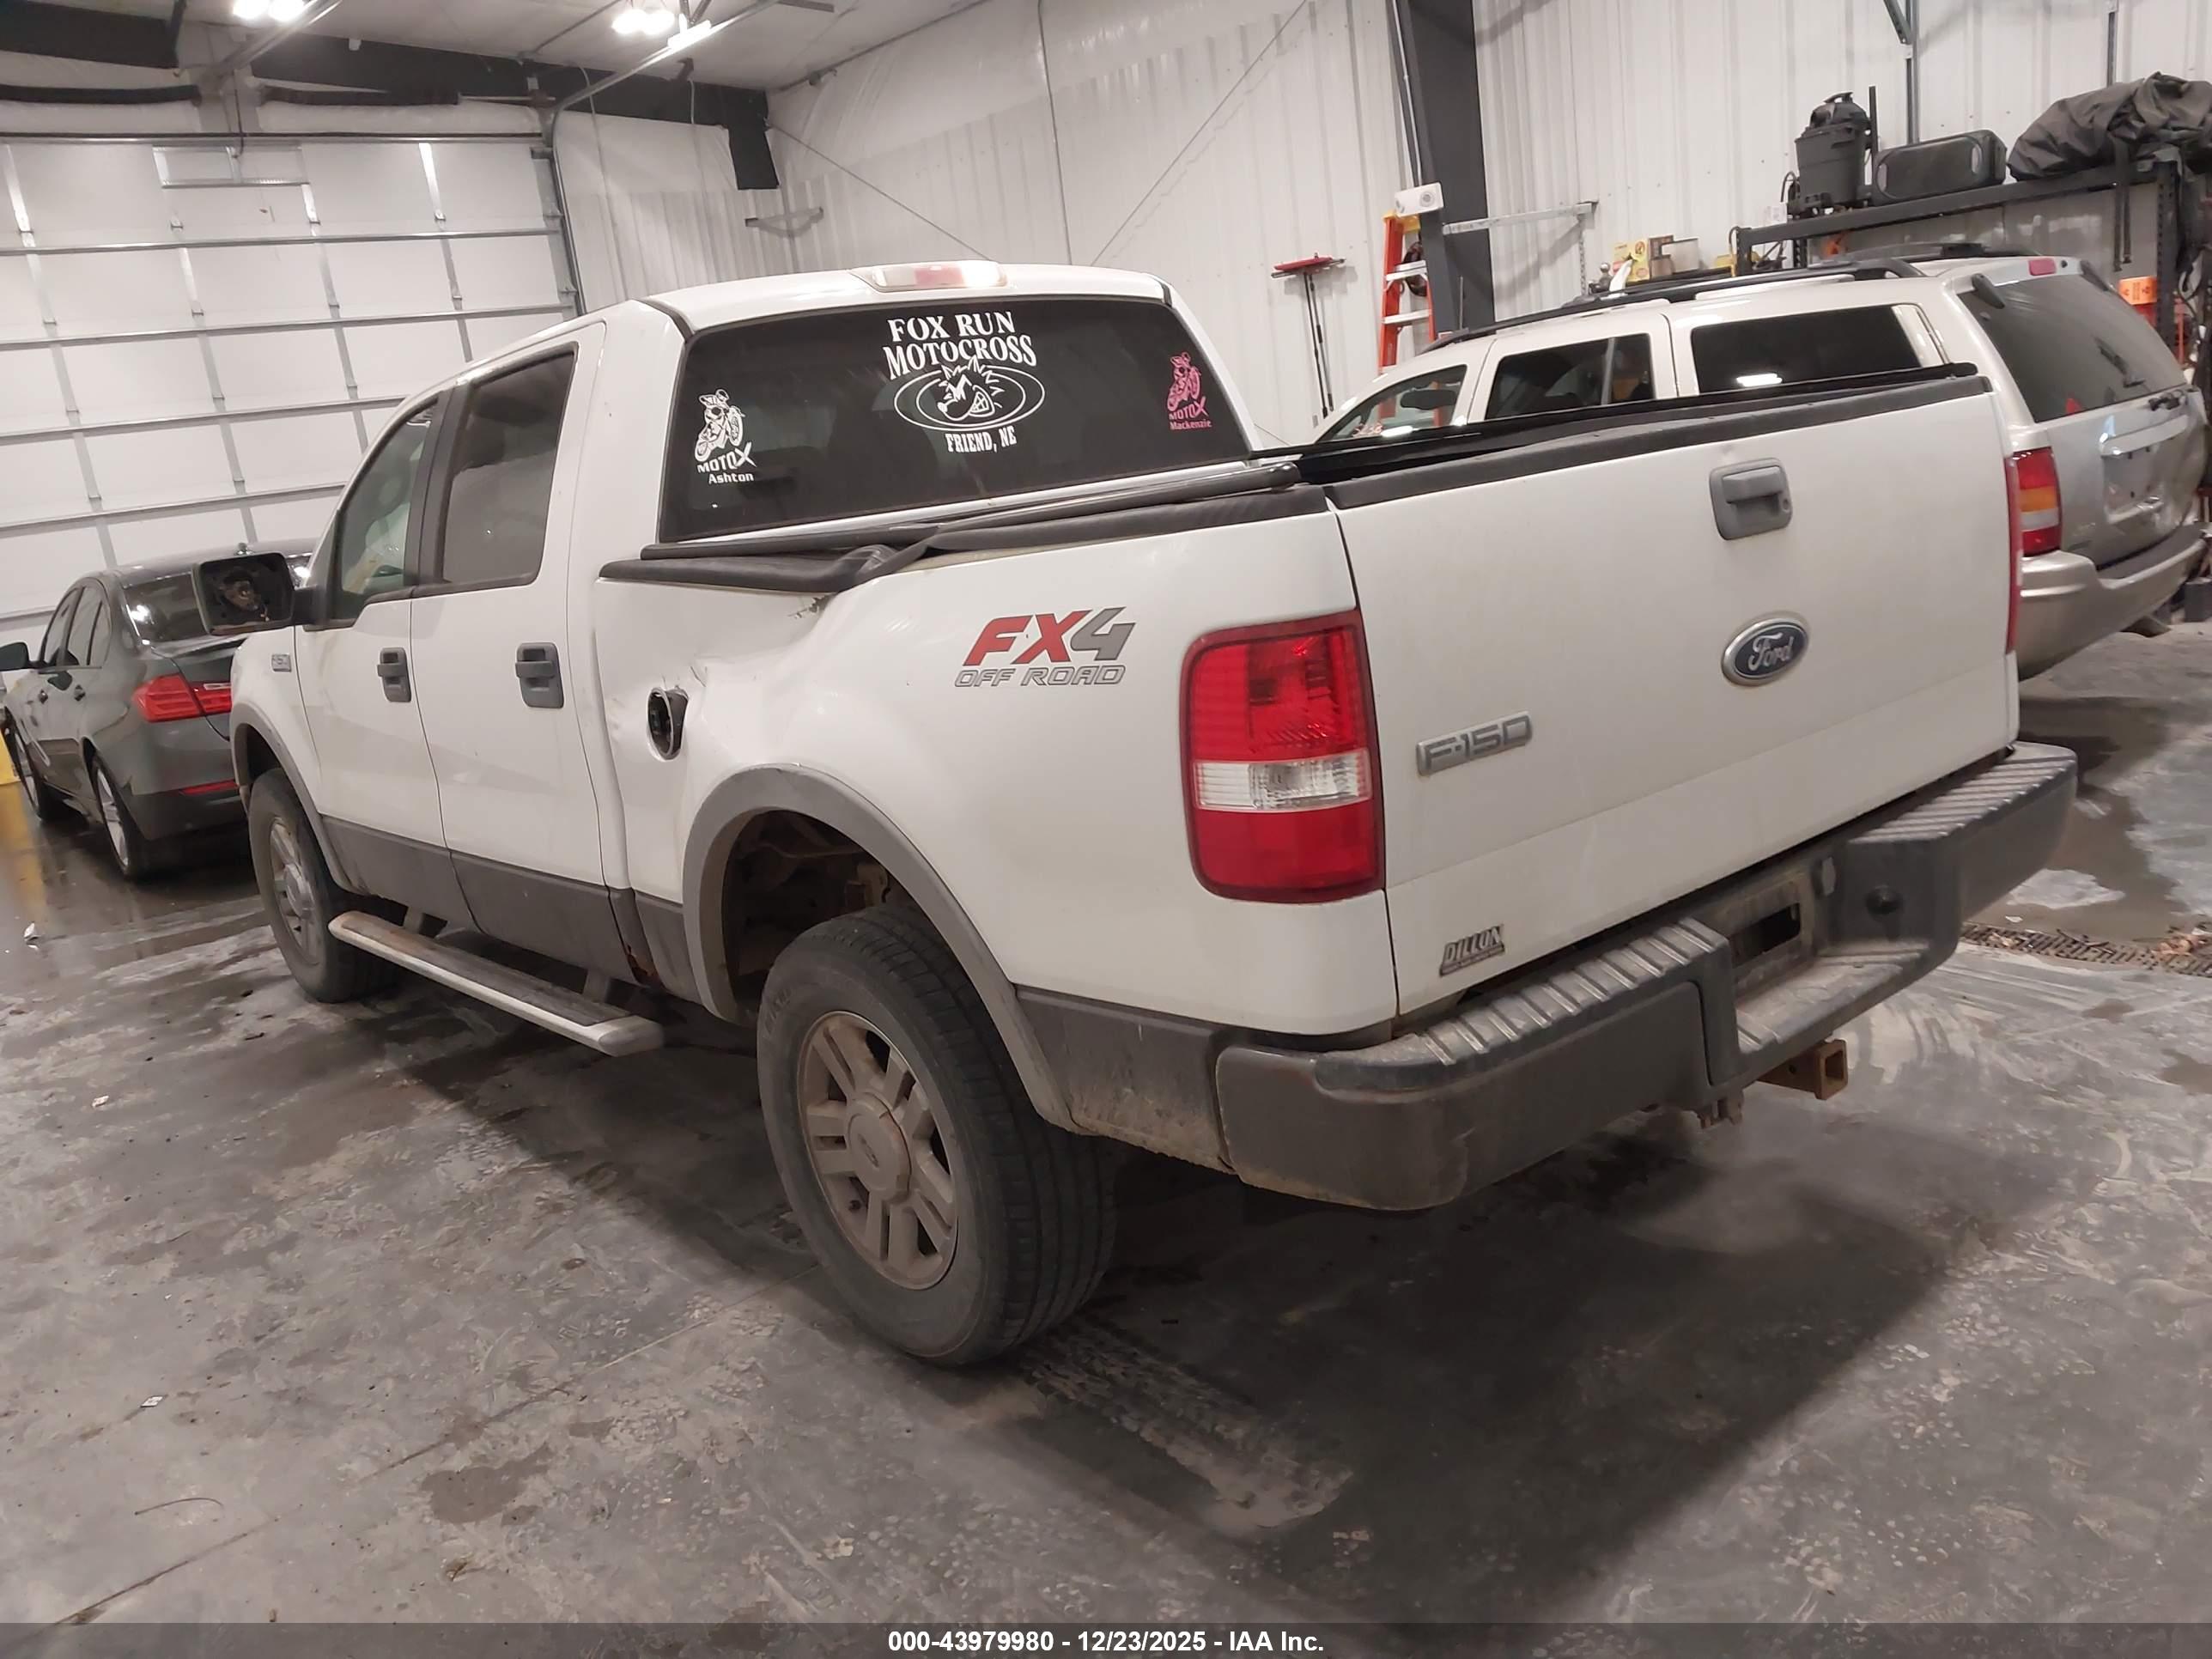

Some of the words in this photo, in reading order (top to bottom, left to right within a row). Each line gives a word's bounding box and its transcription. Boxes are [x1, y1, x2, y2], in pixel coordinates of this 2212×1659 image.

[888, 315, 951, 342] FOX
[955, 311, 1016, 337] RUN
[883, 334, 1037, 380] MOTOCROSS
[945, 431, 998, 453] FRIEND,
[999, 425, 1017, 447] NE
[708, 472, 755, 485] Ashton
[963, 606, 1136, 666] FX4
[1747, 631, 1795, 671] Ford
[954, 668, 1016, 687] OFF
[1020, 665, 1126, 686] ROAD
[1443, 925, 1504, 965] DILLON
